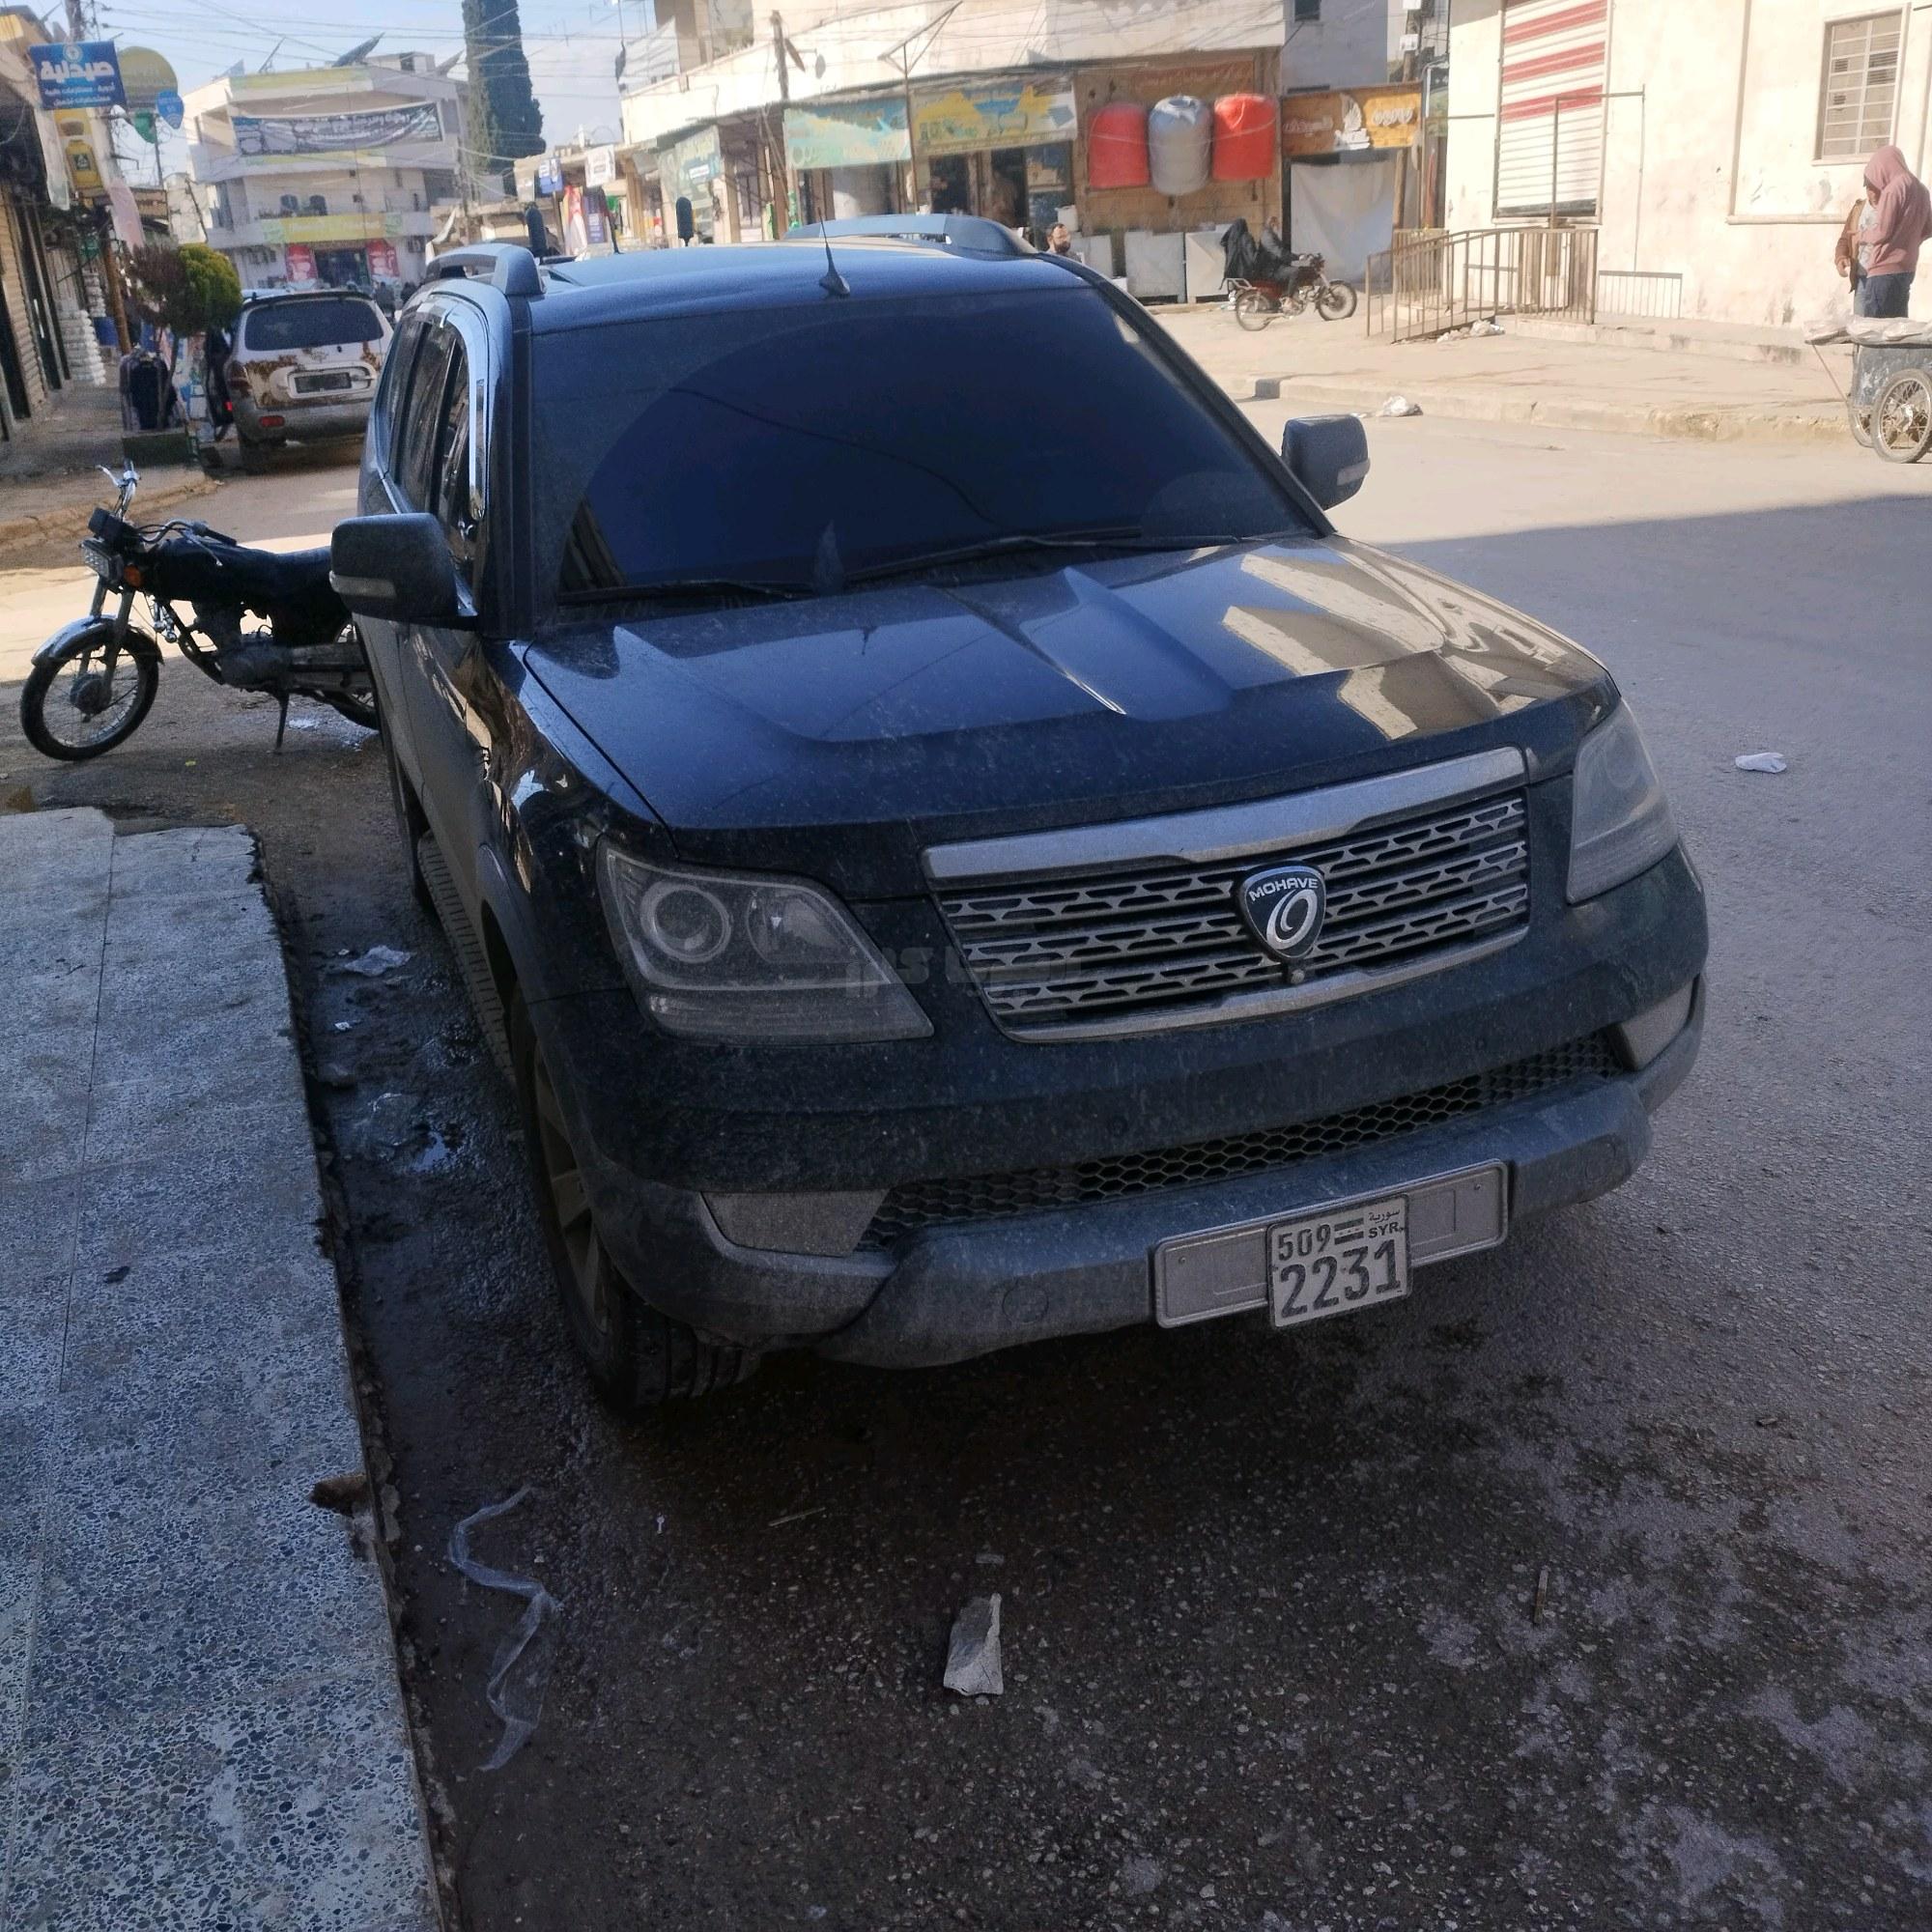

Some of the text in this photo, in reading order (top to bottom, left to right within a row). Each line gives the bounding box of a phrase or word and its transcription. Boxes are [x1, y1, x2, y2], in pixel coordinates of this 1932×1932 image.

[41, 60, 115, 84] صيدلية
[1248, 877, 1319, 902] MOHAVE
[1368, 1209, 1401, 1225] سورية
[1368, 1221, 1401, 1239] SYR
[1278, 1224, 1331, 1262] 509
[1280, 1239, 1402, 1319] 2231
